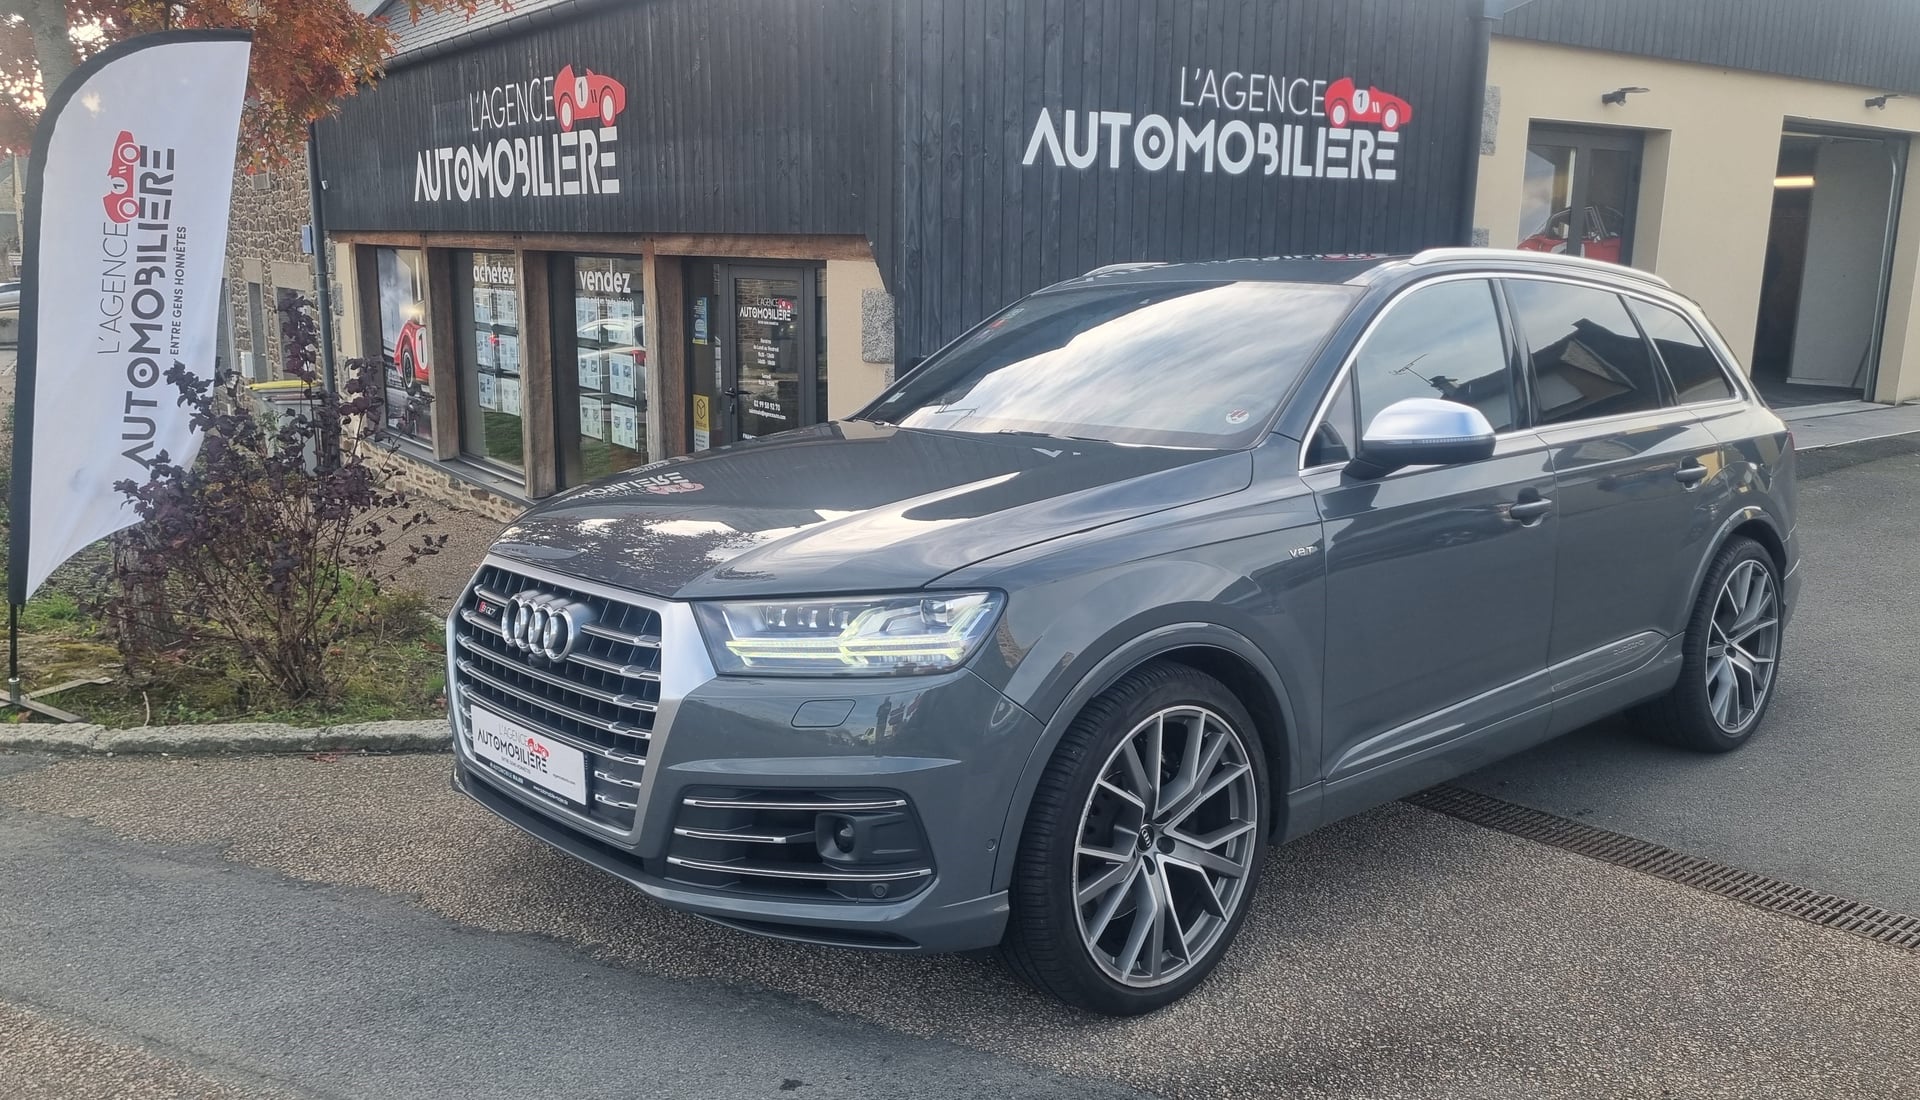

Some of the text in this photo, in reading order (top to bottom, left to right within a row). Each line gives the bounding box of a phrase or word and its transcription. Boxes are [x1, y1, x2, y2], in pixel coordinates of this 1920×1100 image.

[469, 76, 556, 132] L'AGENCE
[1179, 66, 1328, 117] L'AGENCE
[97, 221, 129, 354] L'AGENCE
[169, 226, 187, 355] ENTRE GENS HONNÊTES
[473, 255, 515, 284] achetez
[578, 257, 631, 294] vendez
